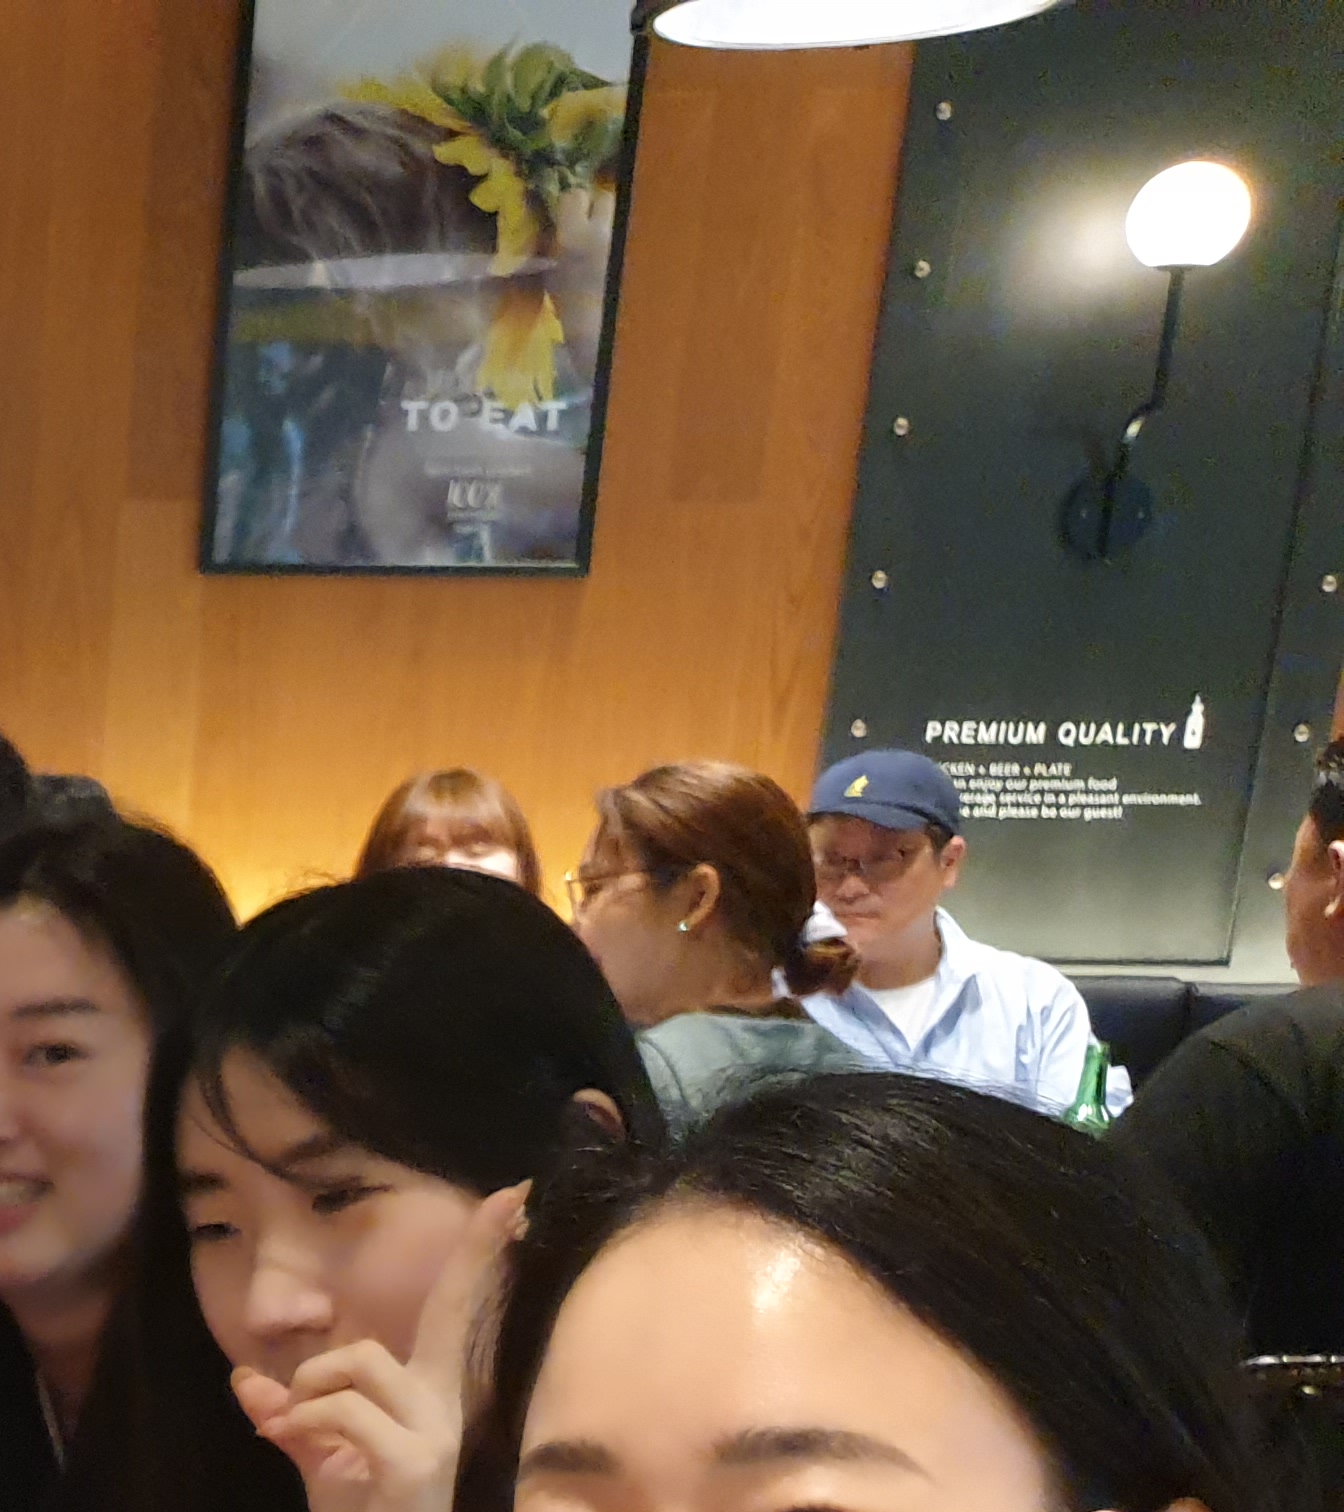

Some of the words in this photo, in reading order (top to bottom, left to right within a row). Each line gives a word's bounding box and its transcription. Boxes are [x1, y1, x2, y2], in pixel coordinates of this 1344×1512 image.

[401, 400, 459, 432] TO
[482, 400, 568, 434] EAT
[924, 720, 1047, 745] PREMIUM
[1057, 720, 1178, 747] QUALITY
[989, 762, 1020, 776] BEER
[1029, 778, 1085, 792] premium
[1088, 776, 1118, 791] food
[1068, 790, 1120, 806] pleasant
[998, 803, 1039, 820] please
